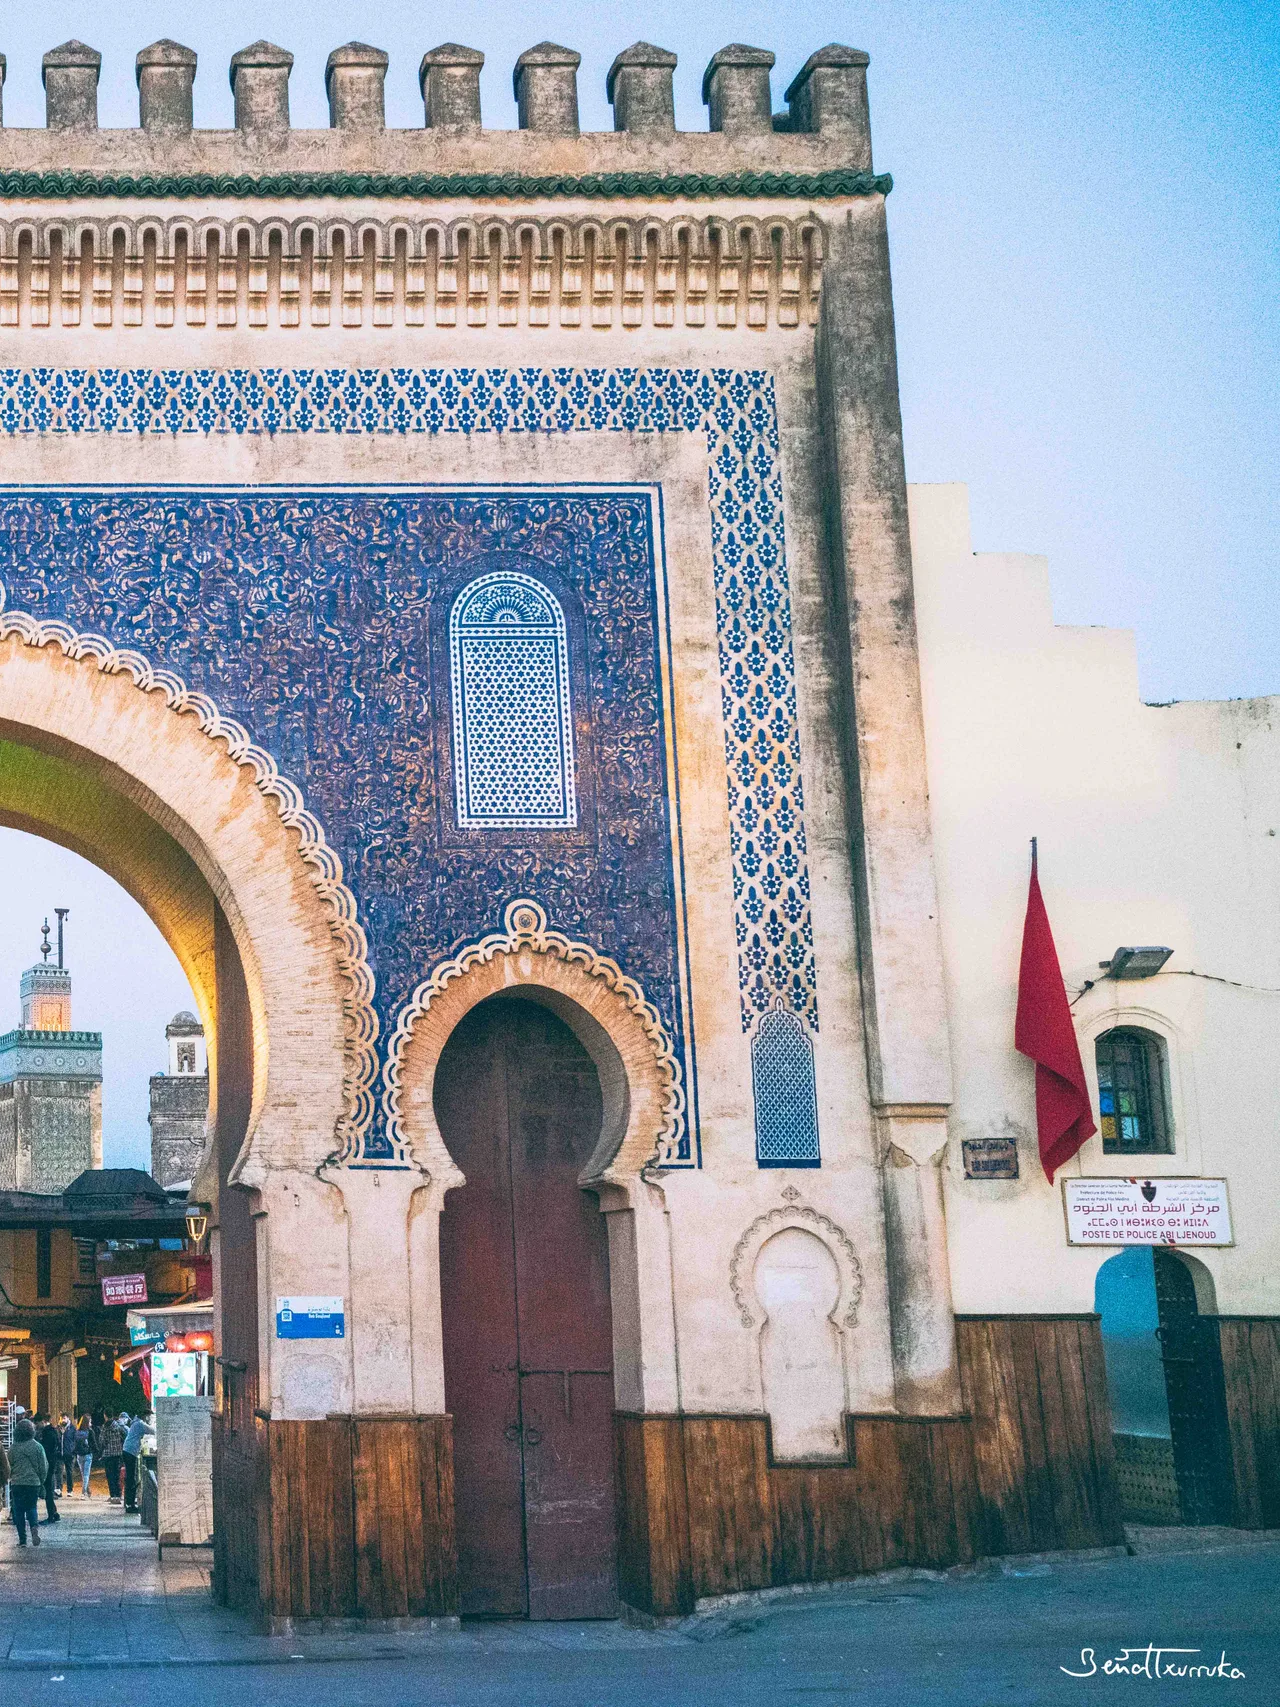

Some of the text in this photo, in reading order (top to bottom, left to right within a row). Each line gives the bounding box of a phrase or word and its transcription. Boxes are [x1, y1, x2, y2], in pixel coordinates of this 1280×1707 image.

[1073, 1201, 1220, 1215] مركز الشرطة أبي الجنود
[1082, 1230, 1217, 1239] POSTE DE POLICE ABI LJENOUD
